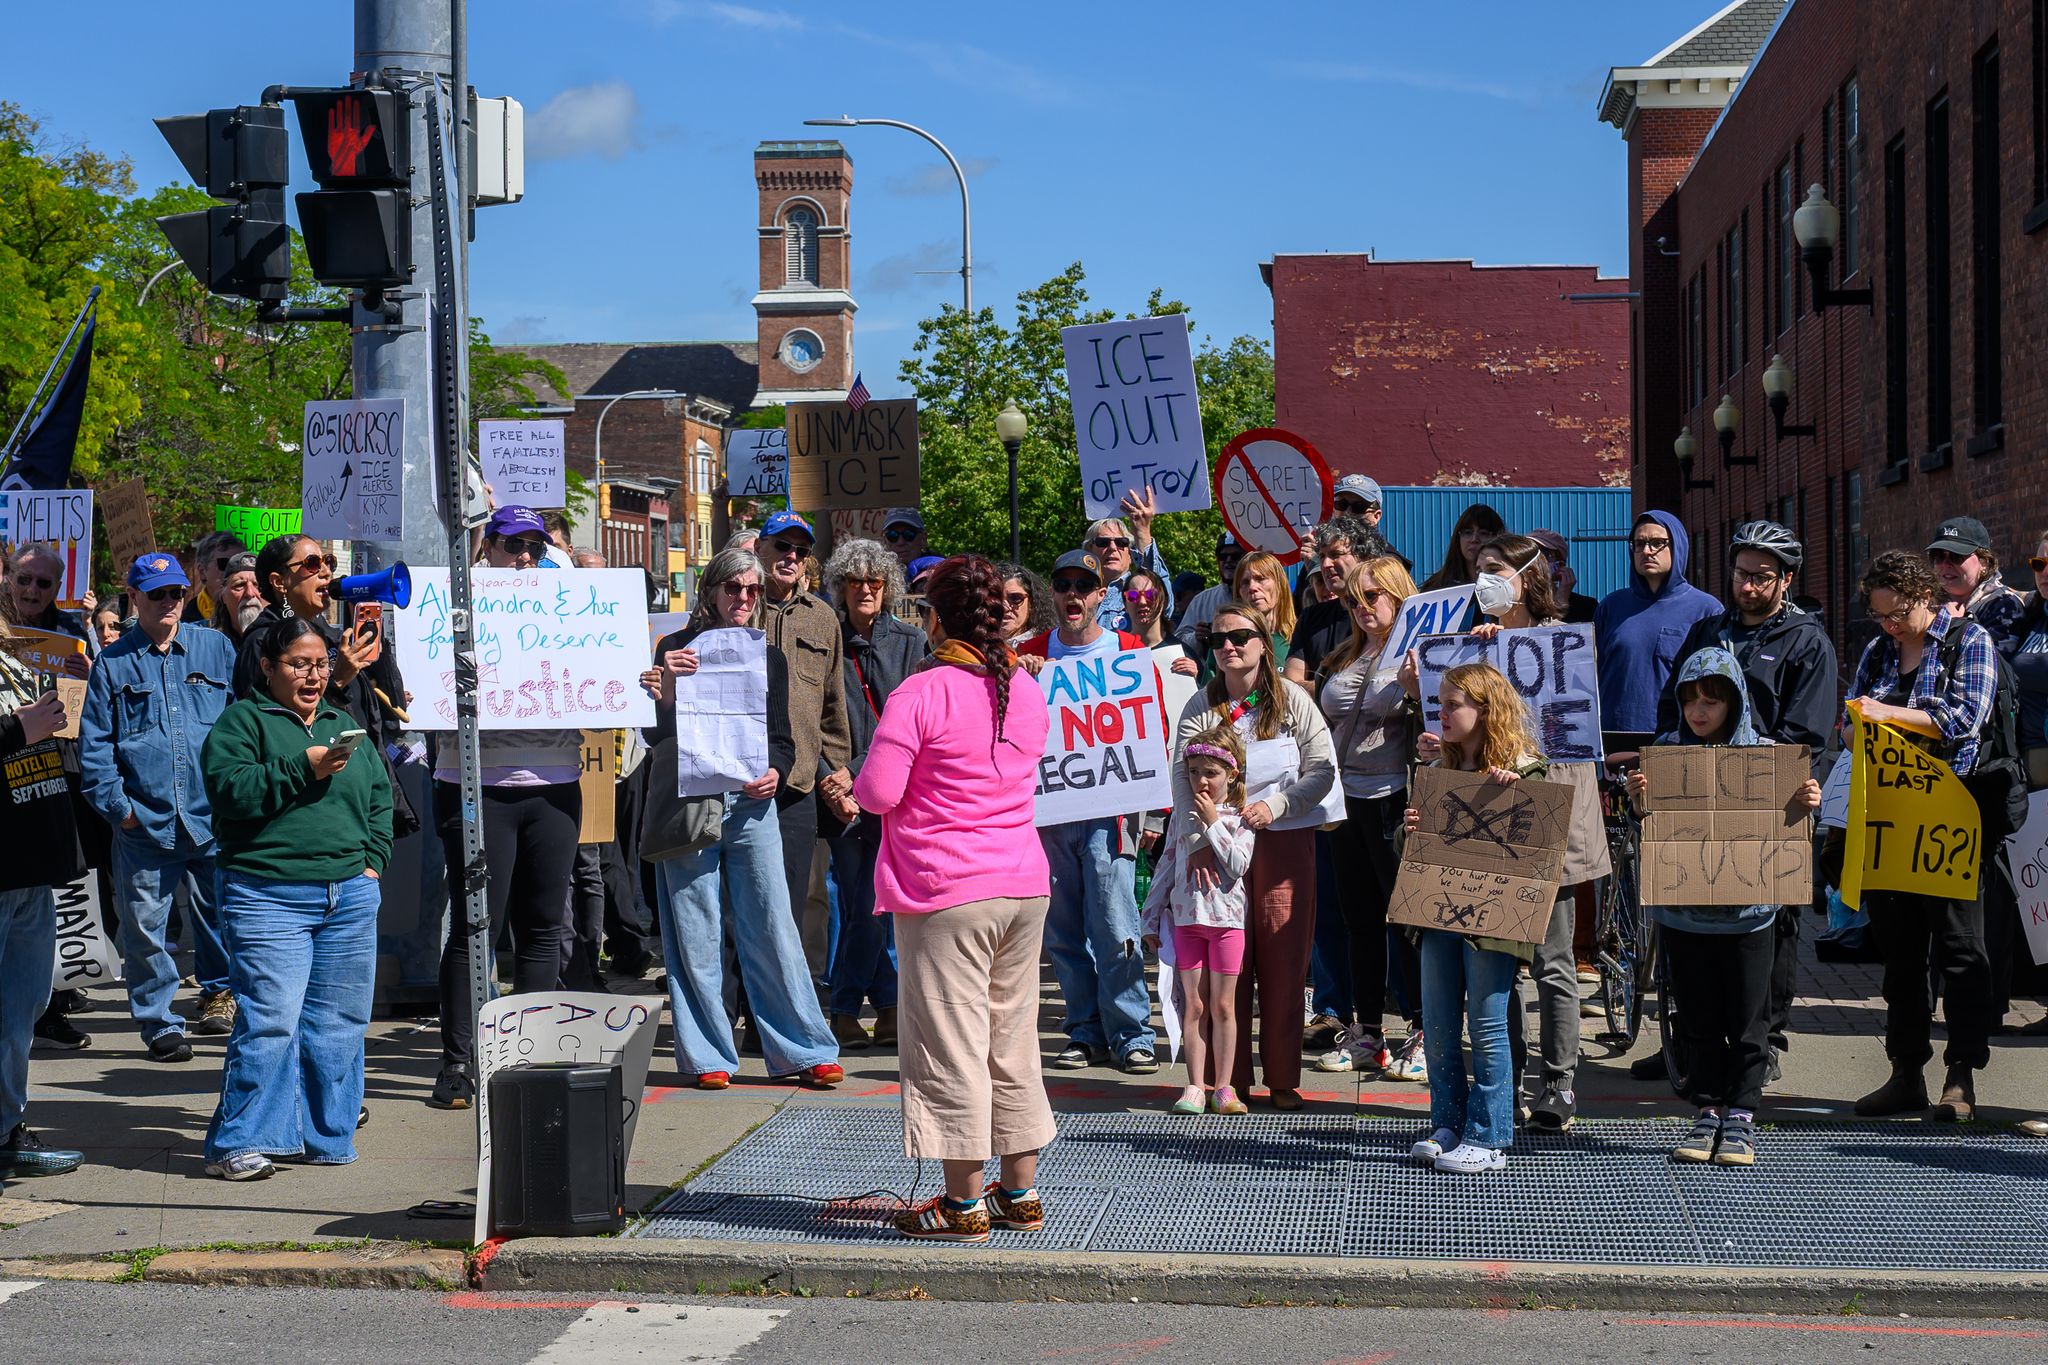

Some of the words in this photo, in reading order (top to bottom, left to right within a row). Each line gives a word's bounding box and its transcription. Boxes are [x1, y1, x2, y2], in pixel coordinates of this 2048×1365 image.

[1089, 331, 1173, 389] ICE
[307, 411, 400, 458] @518CRSC
[795, 406, 906, 457] UNMASK
[1088, 393, 1187, 450] OUT
[489, 430, 523, 442] FREE
[531, 431, 555, 441] ALL
[492, 446, 560, 459] FAMILIES!
[361, 460, 391, 479] ICE
[498, 463, 556, 477] ABOLISH
[762, 461, 784, 474] de
[822, 456, 902, 497] ICE
[1229, 465, 1312, 495] SECRET
[362, 480, 393, 492] ALERTS
[508, 481, 549, 493] ICE!
[743, 473, 786, 495] ALBA
[1091, 469, 1123, 502] OF
[16, 495, 85, 544] MELTS
[362, 496, 388, 516] KYR
[224, 509, 251, 530] ICE
[260, 511, 300, 532] OUT!
[352, 587, 369, 595] PYLE
[575, 584, 620, 617] her
[517, 623, 624, 651] Deserve
[1393, 597, 1466, 659] YAY
[1035, 654, 1142, 705] ANS
[1060, 696, 1153, 752] NOT
[4, 755, 42, 780] HOTEL
[1640, 750, 1775, 803] ICE
[1877, 768, 1941, 794] LAST
[1911, 823, 1978, 880] IS?!
[1469, 869, 1490, 882] hurt
[1460, 884, 1484, 894] hurt
[1486, 887, 1504, 898] you
[55, 873, 103, 982] MAYOR
